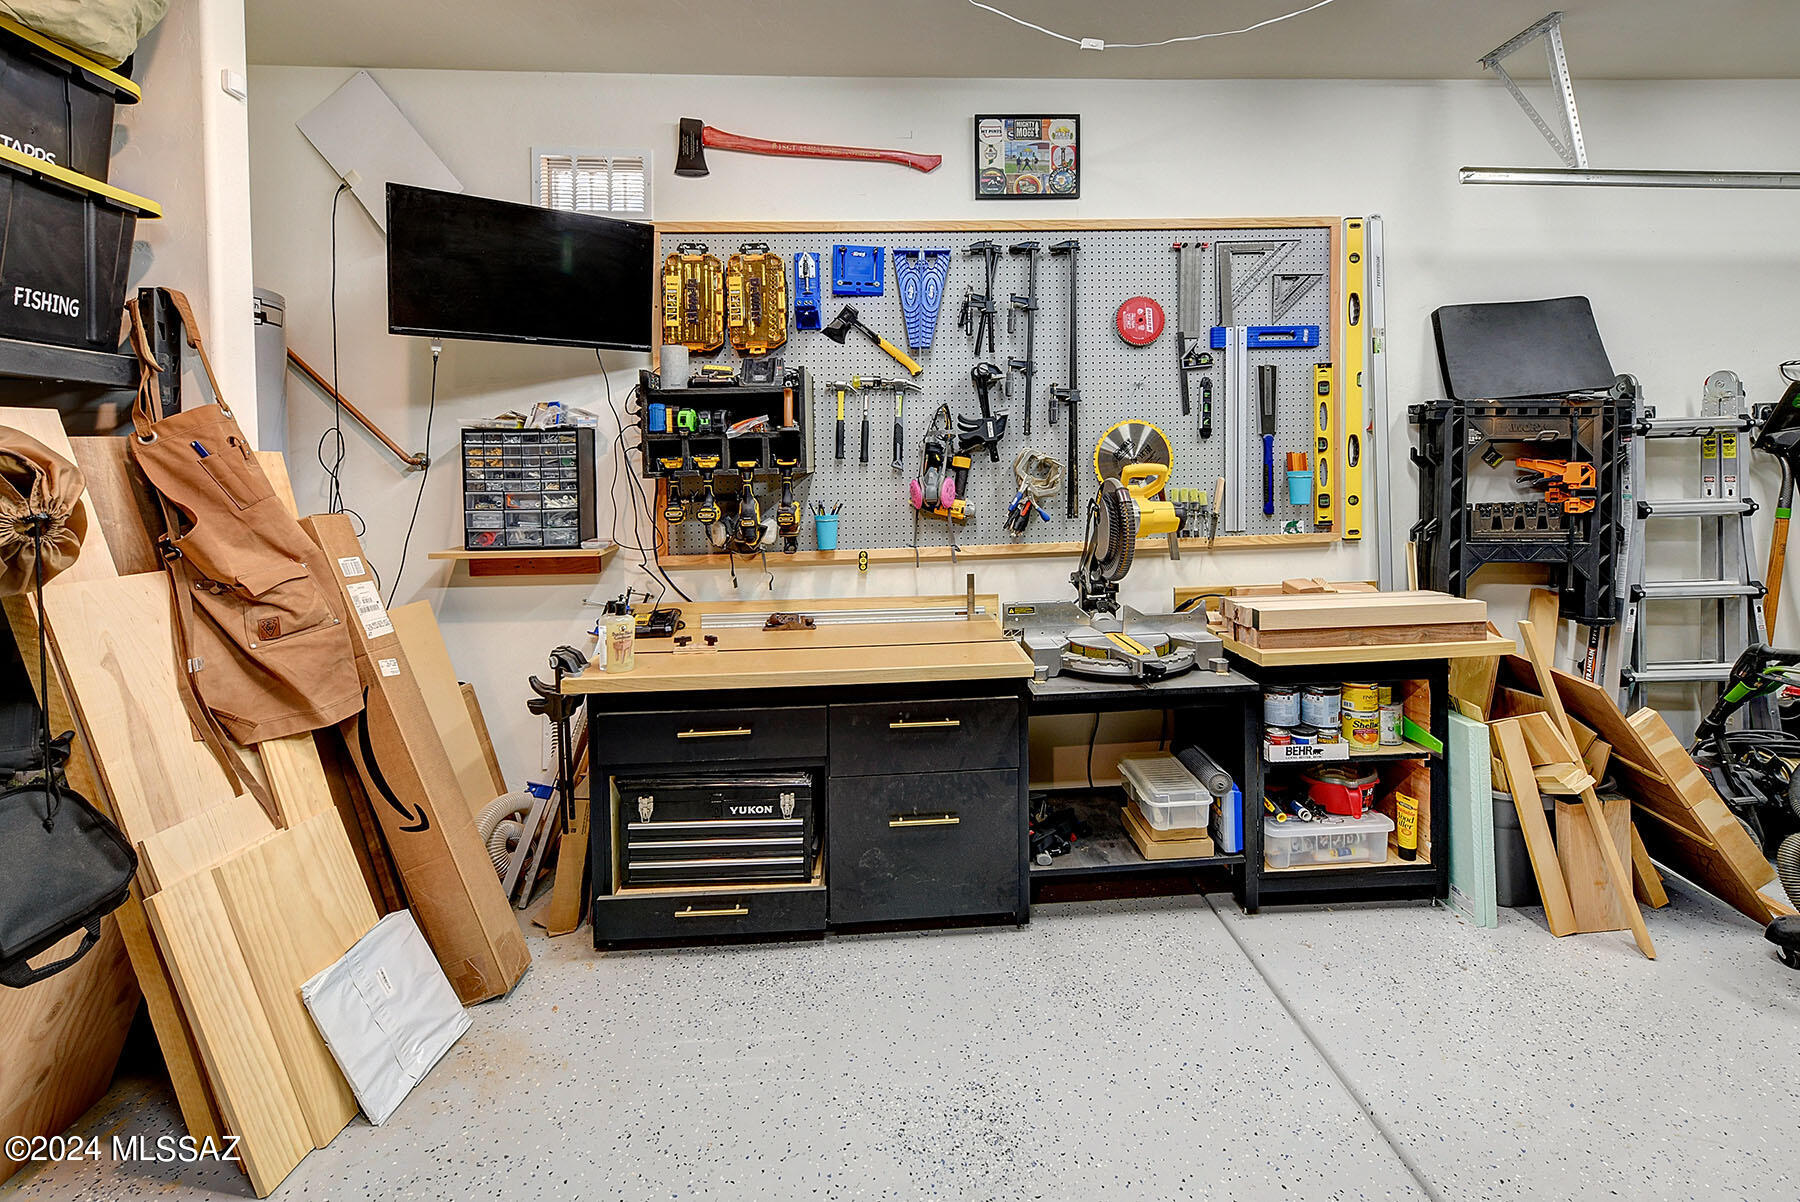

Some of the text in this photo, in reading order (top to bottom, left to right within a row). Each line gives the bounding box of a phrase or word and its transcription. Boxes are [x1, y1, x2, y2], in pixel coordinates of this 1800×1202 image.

[13, 286, 80, 318] FISHING
[1353, 720, 1378, 729] Shella
[1286, 746, 1313, 756] BEHR
[730, 805, 774, 815] YUKON
